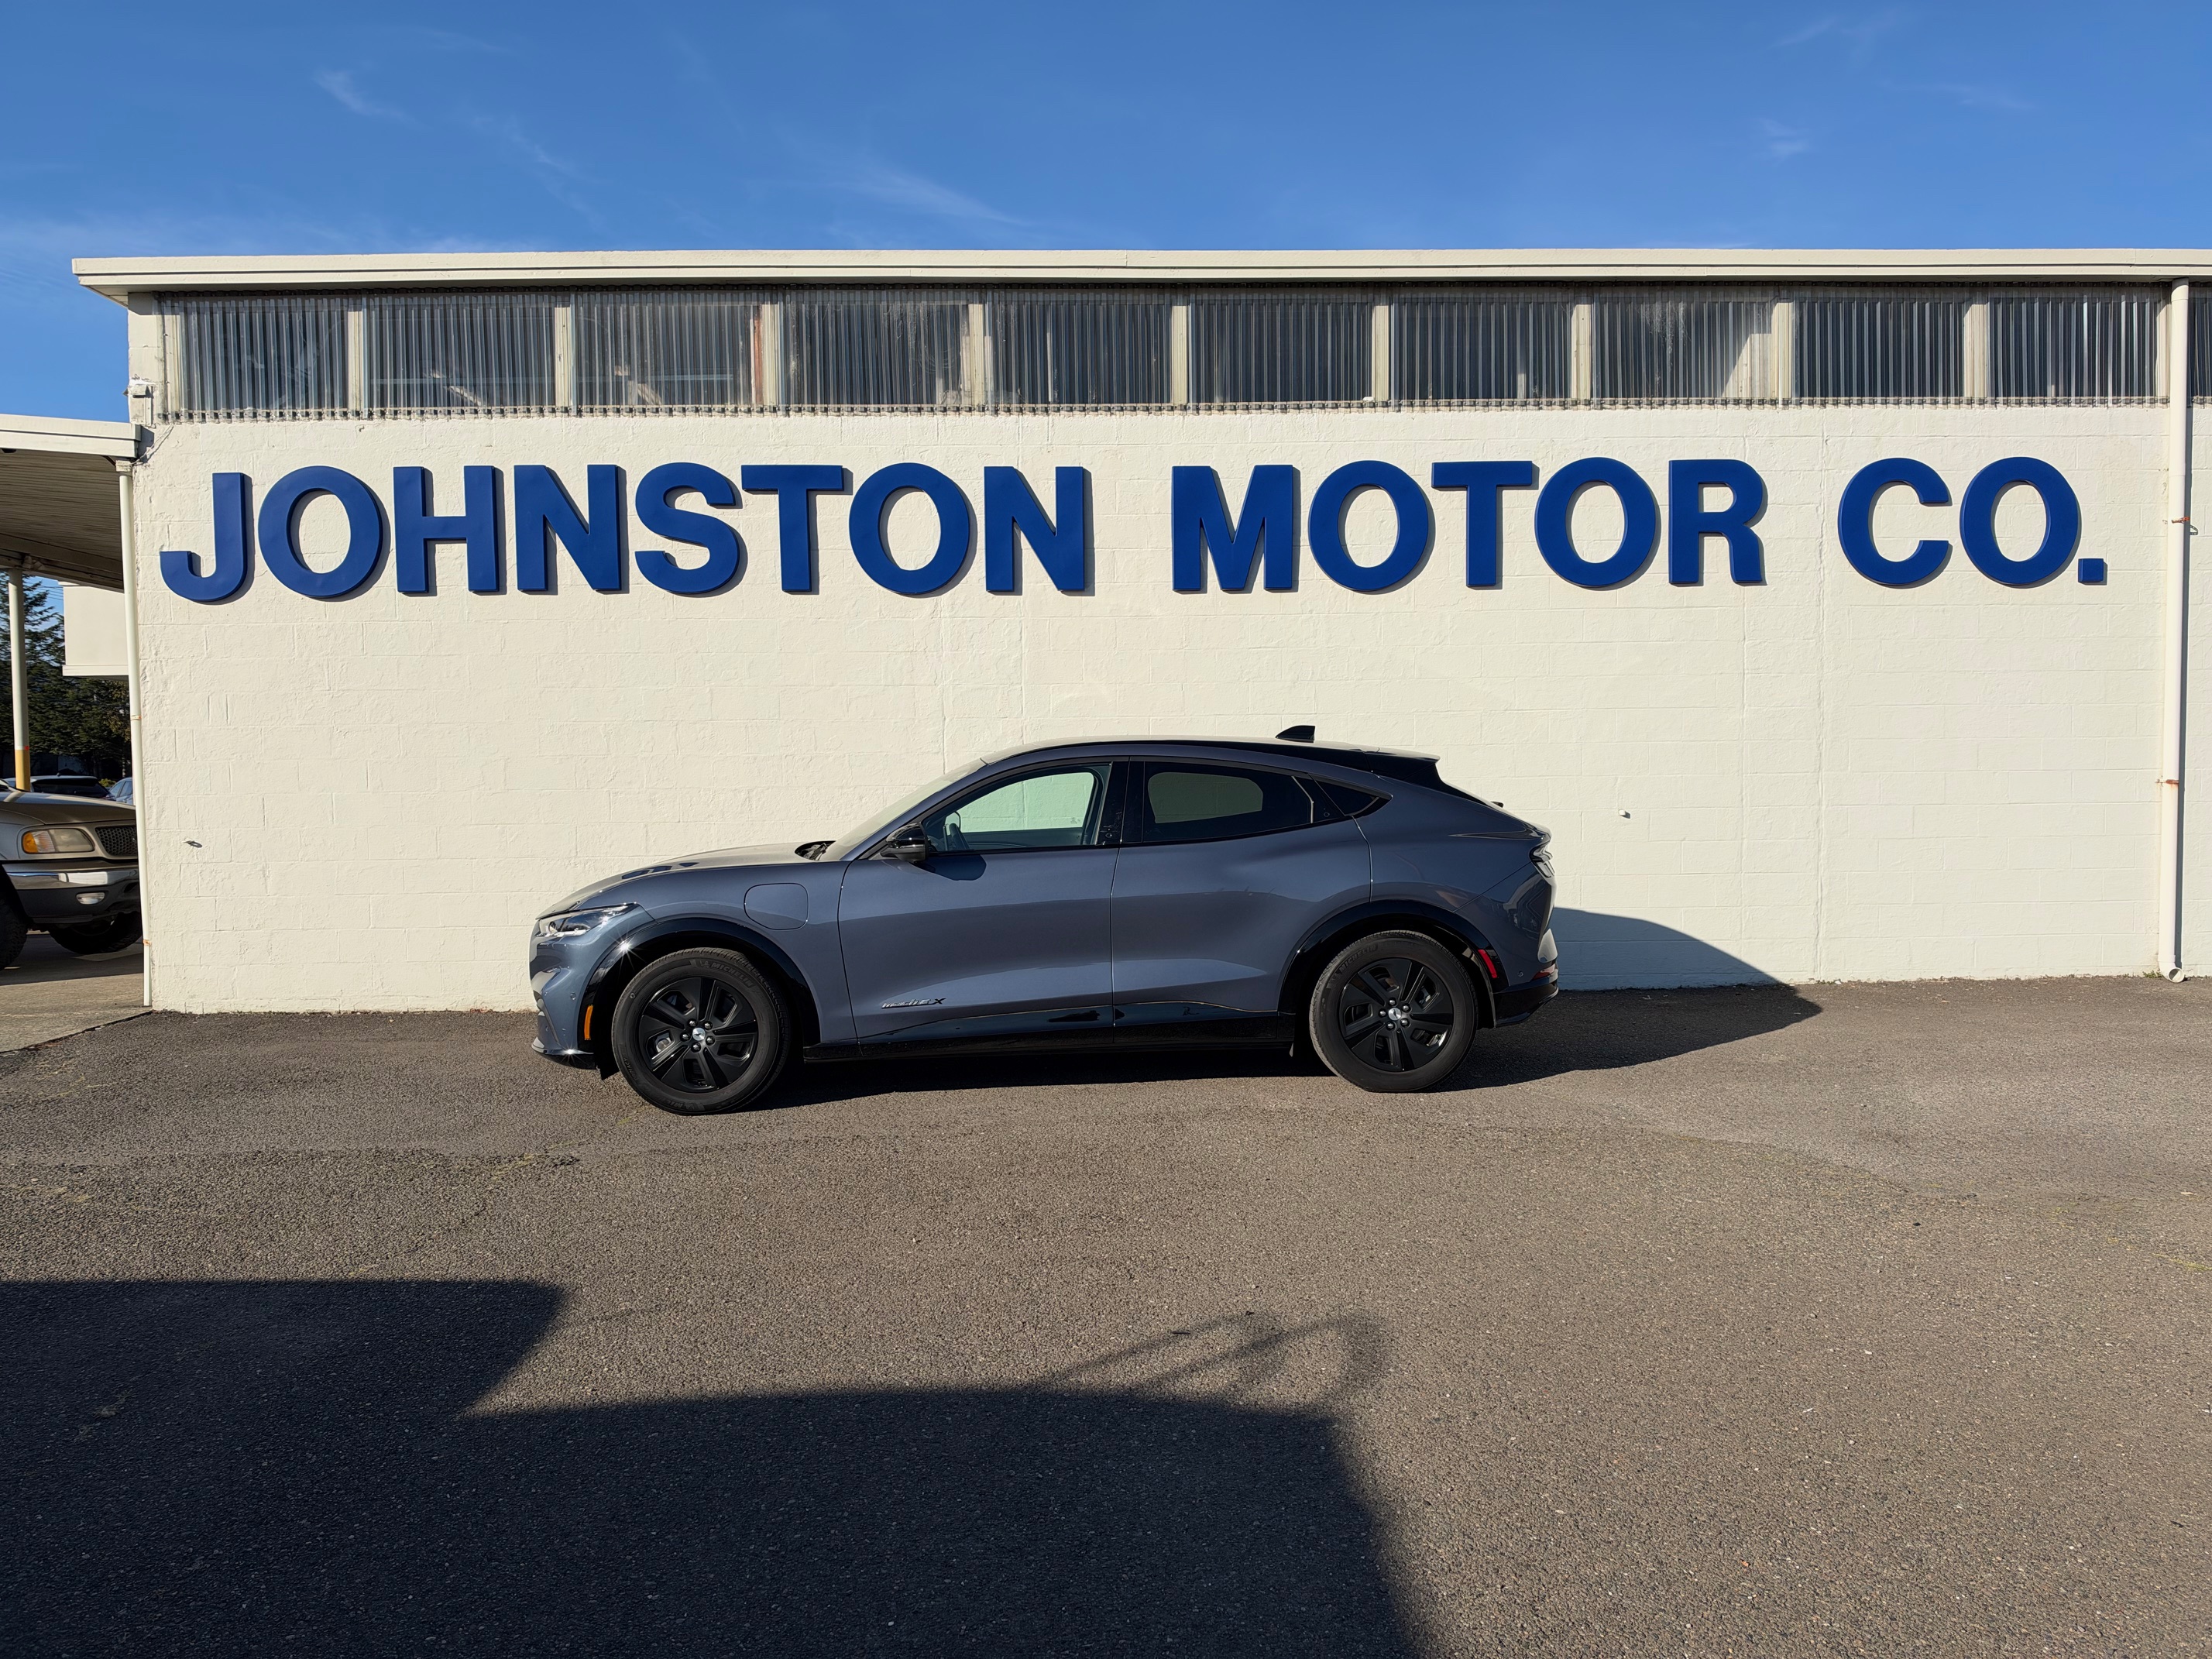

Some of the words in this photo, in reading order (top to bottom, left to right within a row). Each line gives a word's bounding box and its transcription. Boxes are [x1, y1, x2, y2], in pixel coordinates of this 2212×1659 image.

[160, 462, 1089, 603] JOHNSTON
[1173, 457, 1767, 592] MOTOR
[1837, 456, 2105, 586] CO.
[710, 962, 754, 988] MICHELIN
